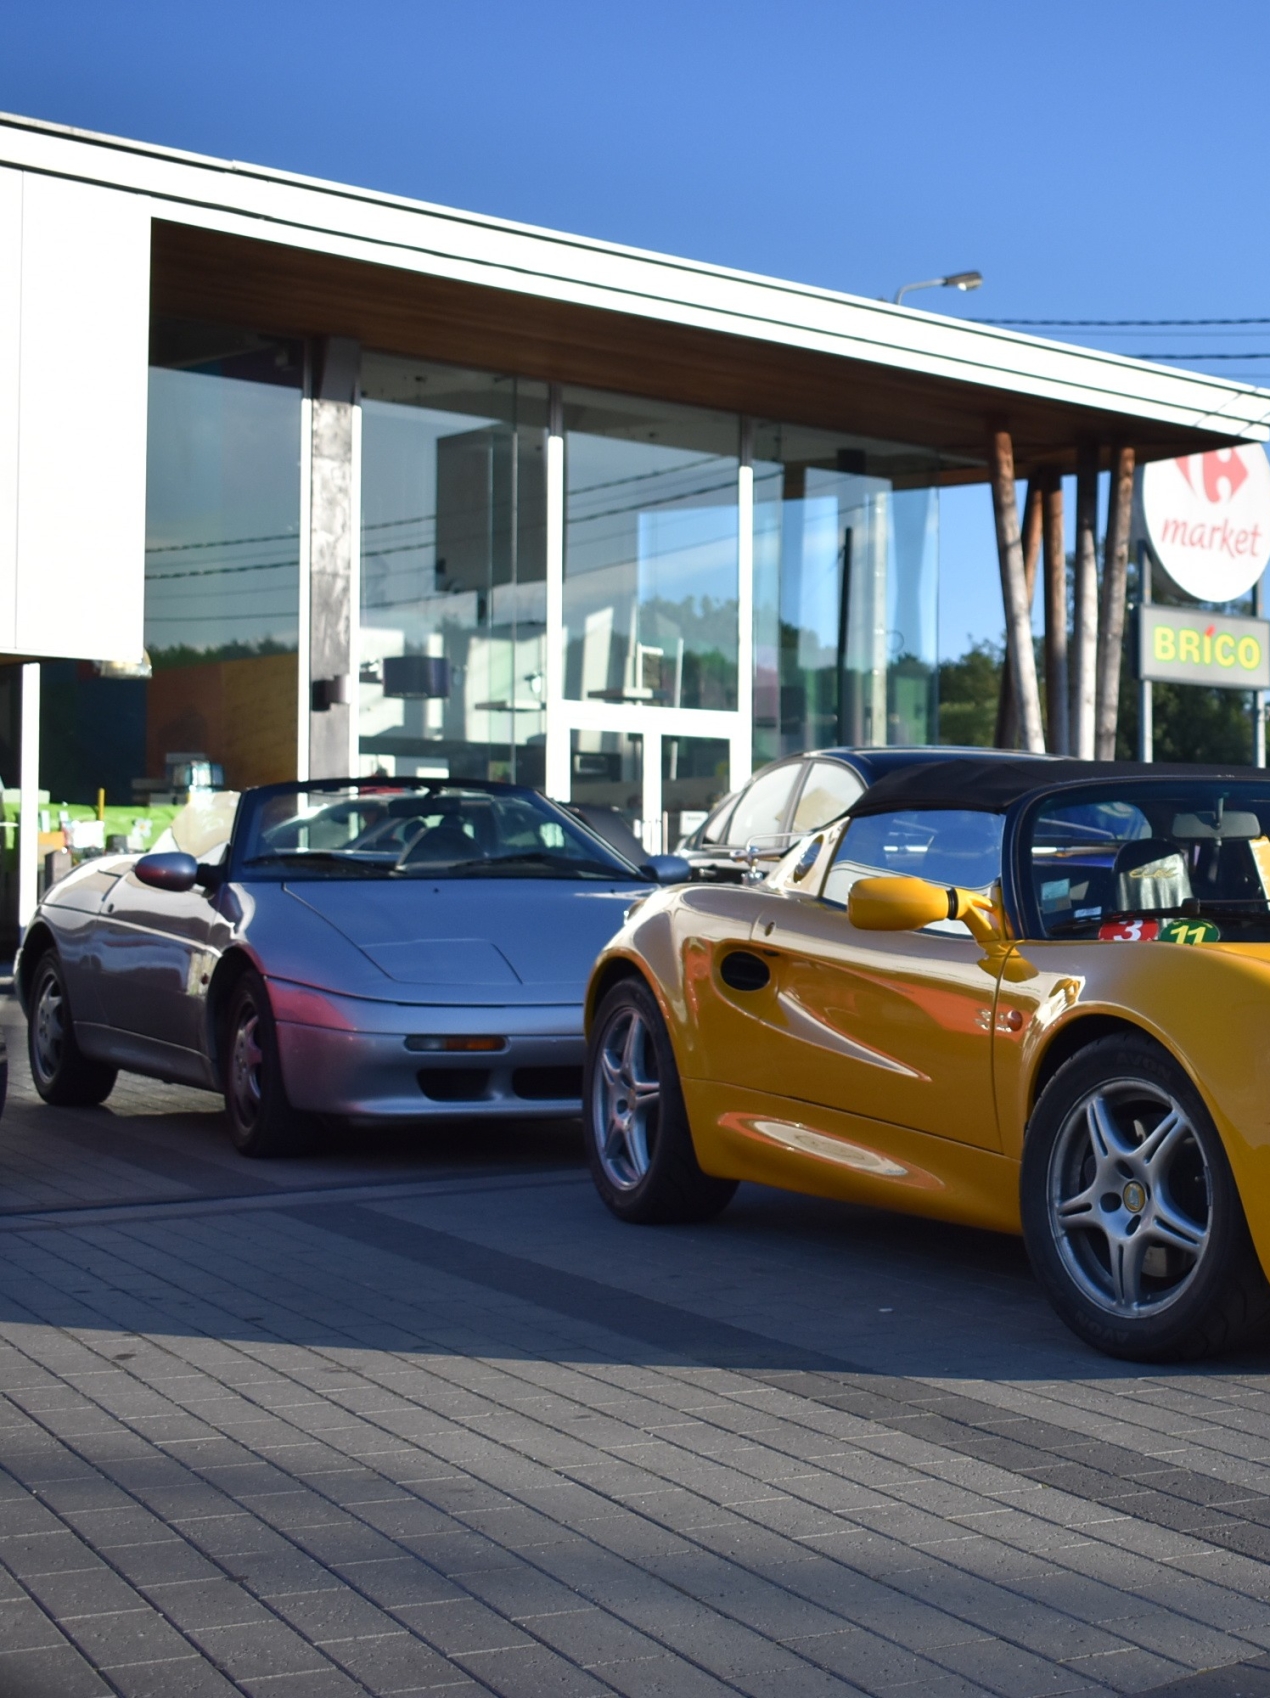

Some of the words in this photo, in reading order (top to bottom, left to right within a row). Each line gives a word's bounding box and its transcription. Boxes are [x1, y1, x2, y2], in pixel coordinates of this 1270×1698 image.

[1161, 517, 1262, 559] market
[1153, 623, 1261, 671] BRICO
[1113, 919, 1144, 941] 3
[1170, 924, 1207, 945] 11
[1115, 1051, 1172, 1081] AVON
